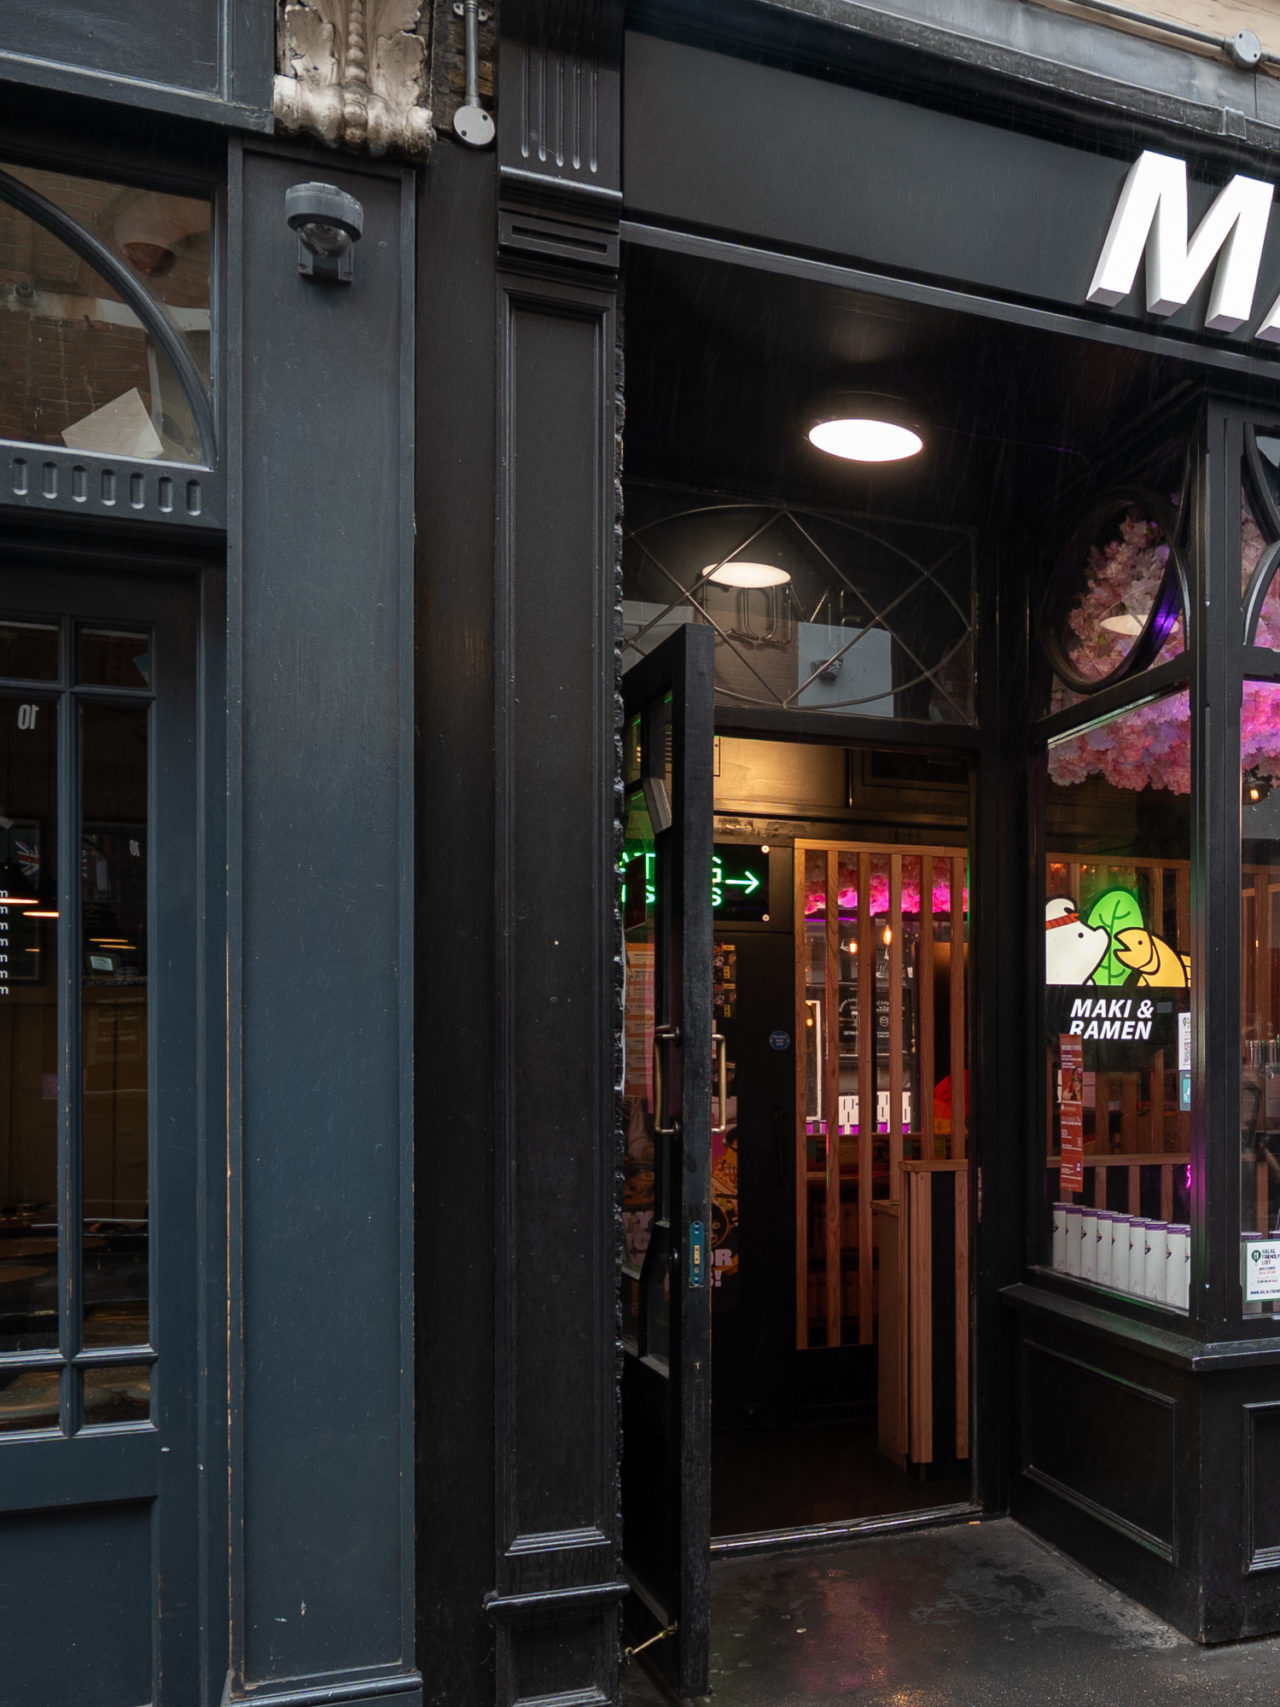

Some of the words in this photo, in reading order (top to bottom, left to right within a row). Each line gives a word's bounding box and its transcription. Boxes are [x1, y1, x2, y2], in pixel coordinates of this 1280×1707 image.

[1070, 998, 1133, 1019] MAKI
[1137, 998, 1155, 1019] &
[1069, 1020, 1153, 1041] RAMEN
